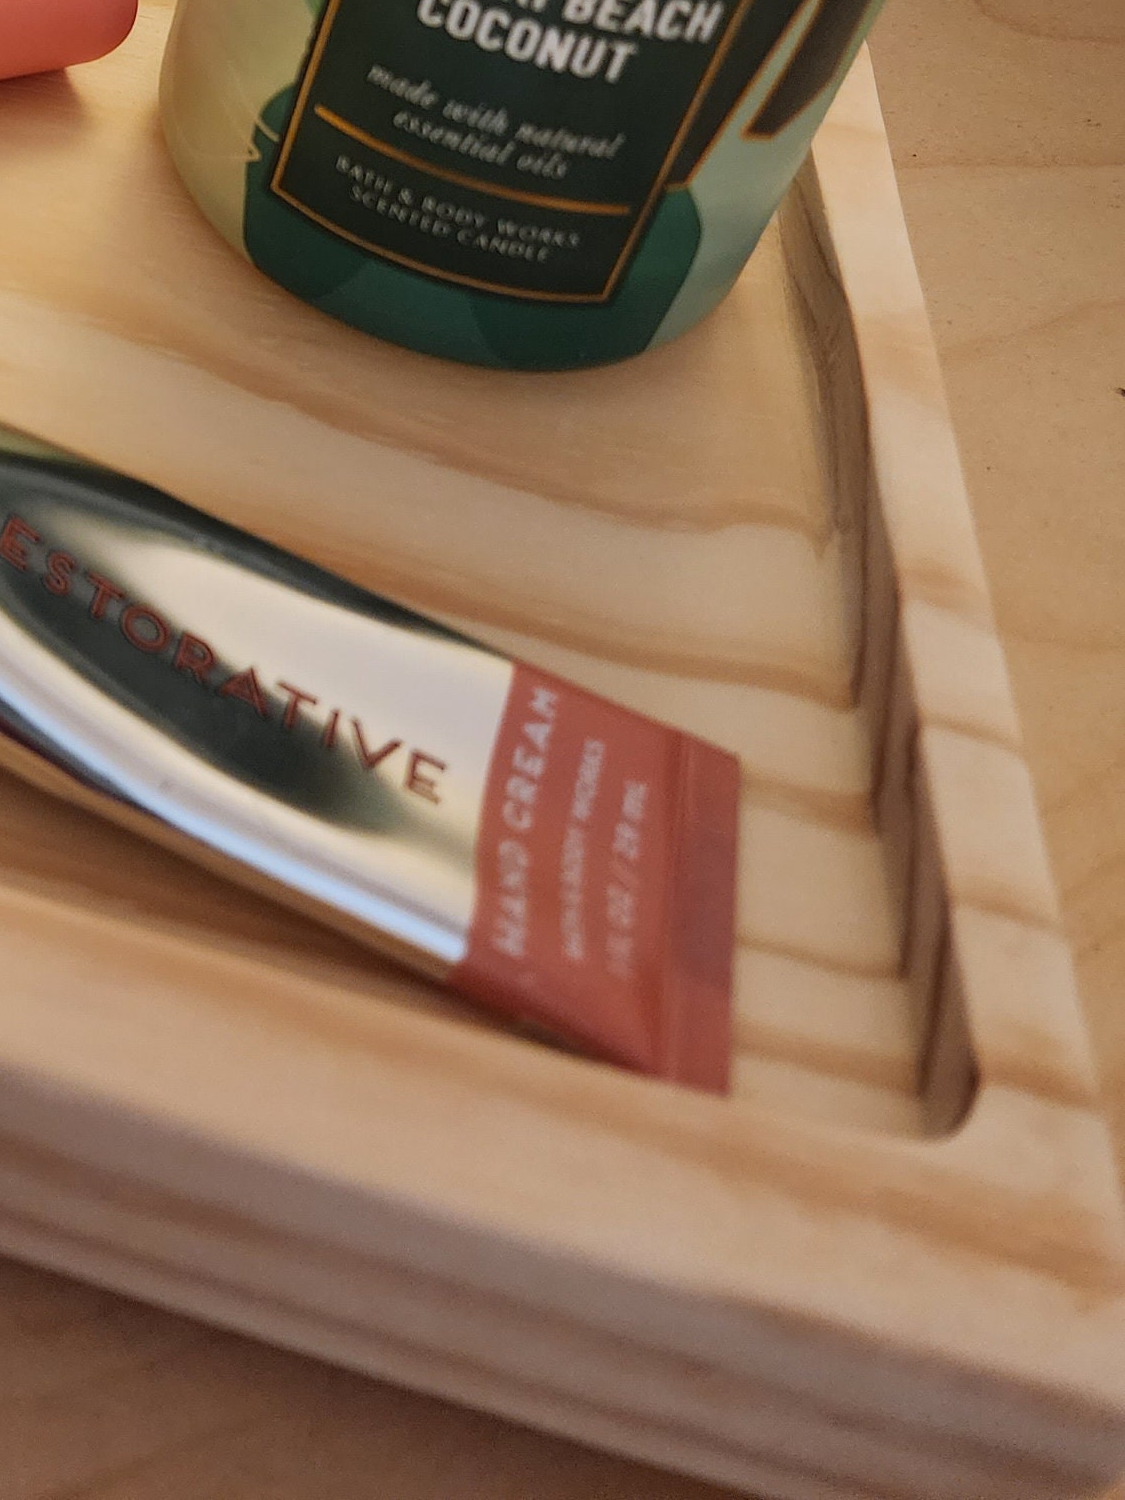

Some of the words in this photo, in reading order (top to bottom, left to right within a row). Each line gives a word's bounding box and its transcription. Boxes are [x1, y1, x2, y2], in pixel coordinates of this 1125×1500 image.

[366, 64, 439, 110] made
[442, 100, 509, 137] with
[515, 122, 626, 160] natural
[393, 110, 516, 167] essential
[516, 152, 568, 181] oils
[336, 154, 394, 196] BATH
[421, 195, 488, 230] BODY
[497, 218, 582, 248] WORKS
[350, 184, 452, 238] SCENTED
[456, 226, 551, 264] CANDLE
[501, 686, 560, 832] CREAM
